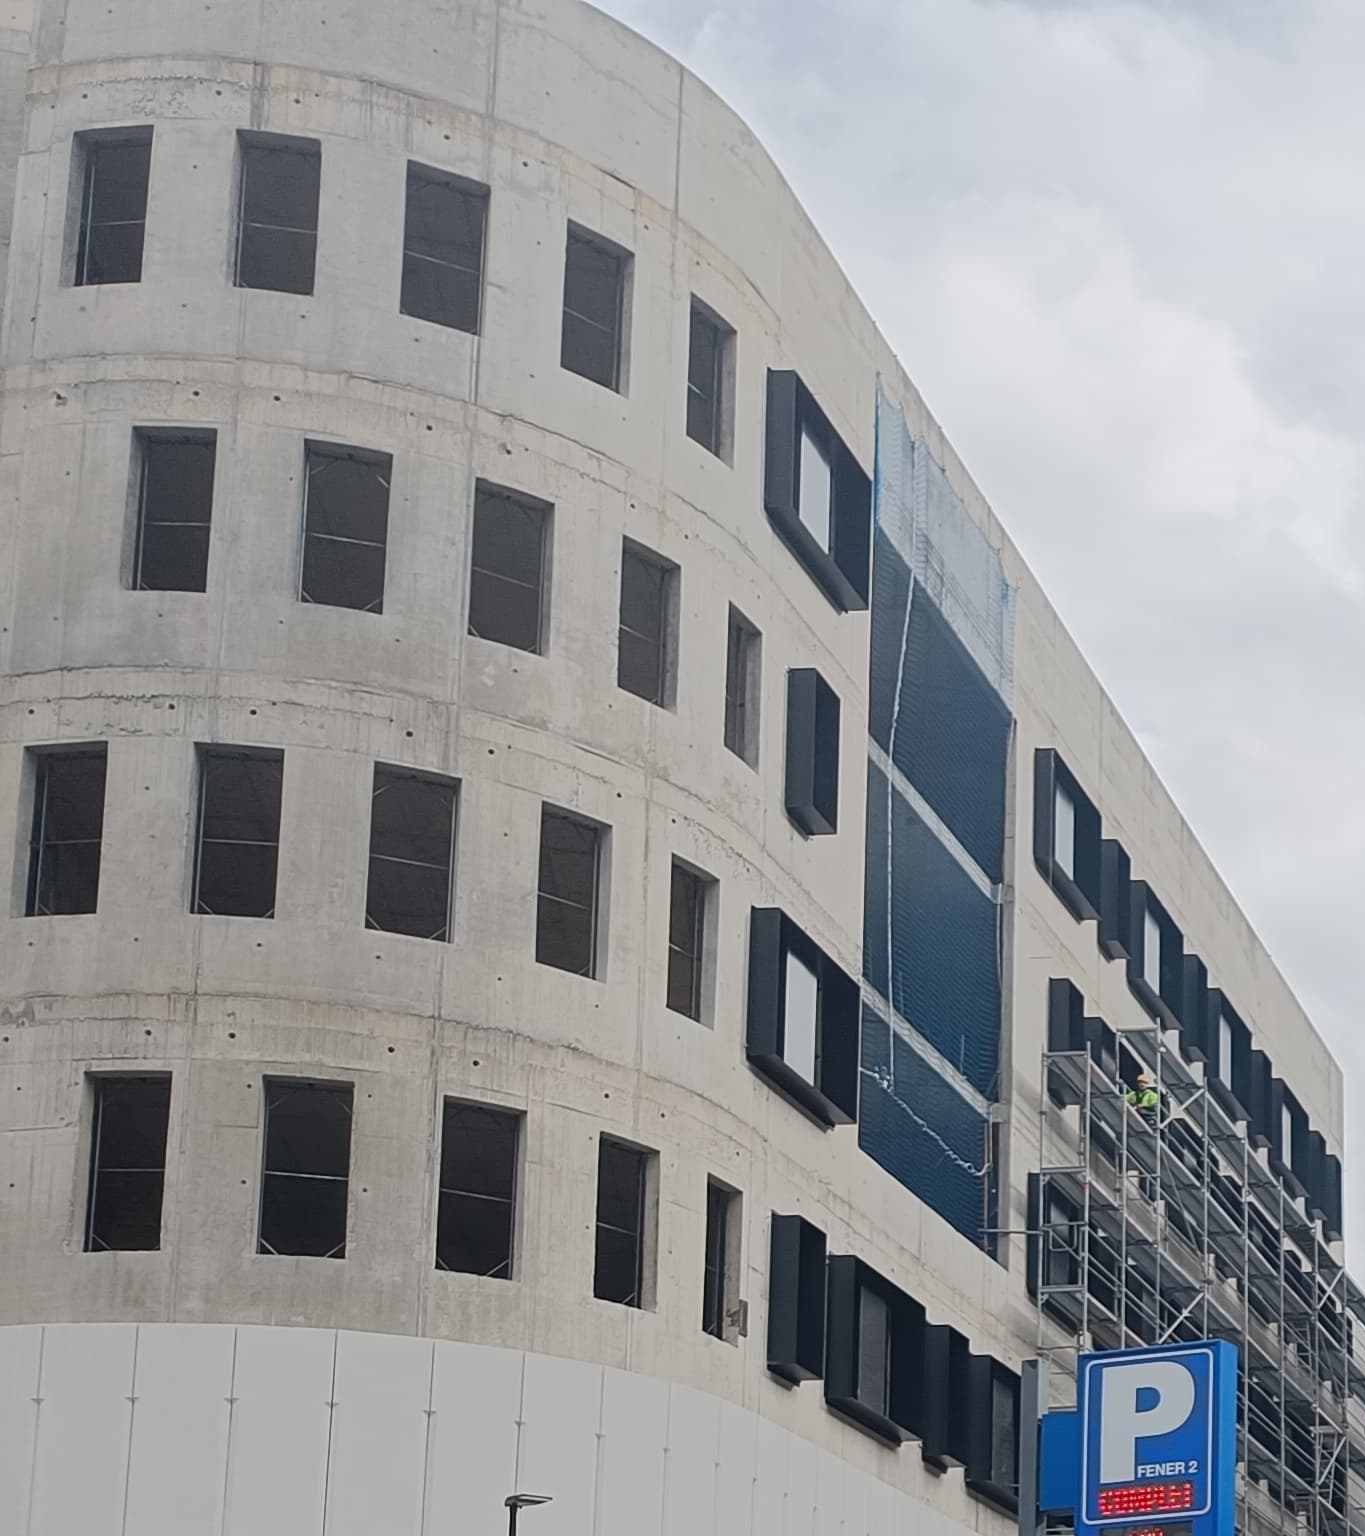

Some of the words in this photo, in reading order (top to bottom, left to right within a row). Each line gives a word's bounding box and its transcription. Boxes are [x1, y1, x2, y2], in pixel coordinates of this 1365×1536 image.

[1100, 1361, 1196, 1484] P
[1137, 1463, 1185, 1479] FENER
[1187, 1460, 1199, 1474] 2
